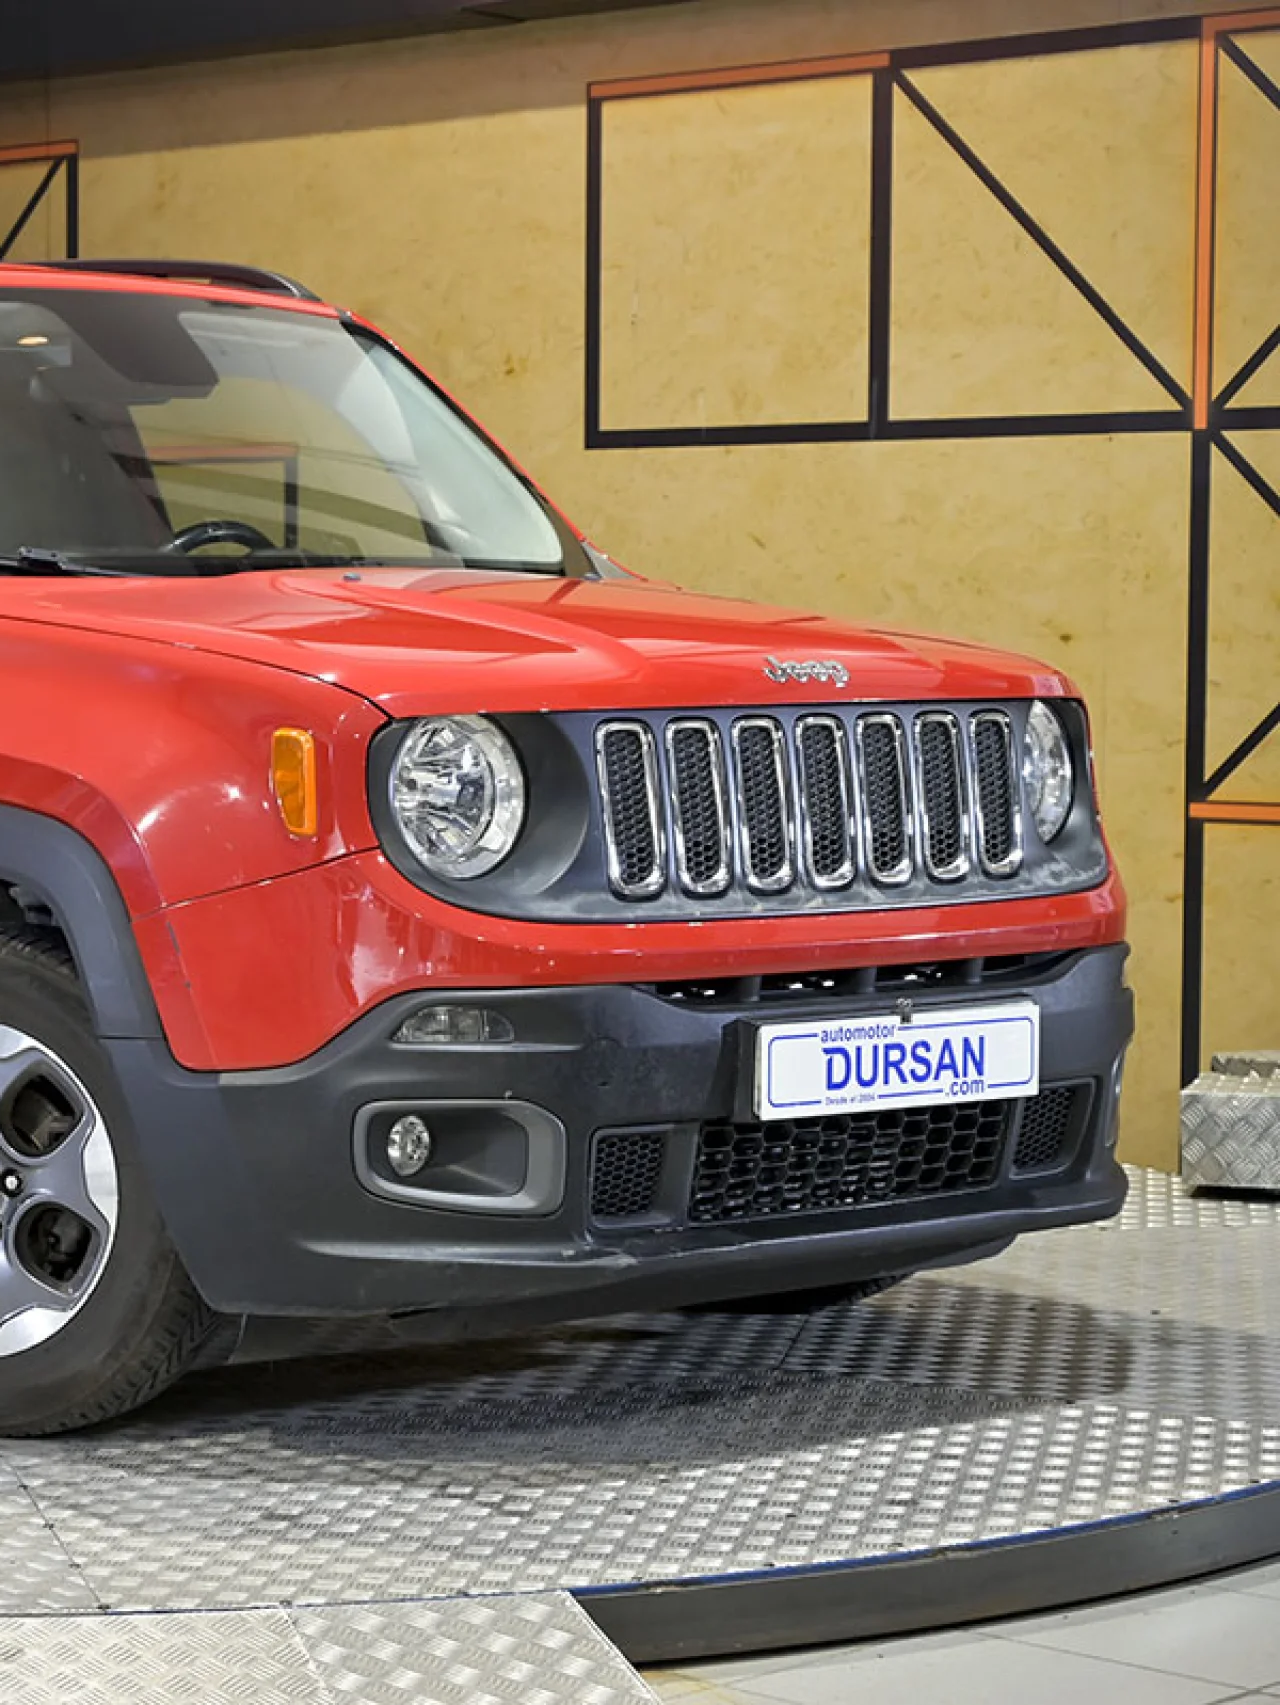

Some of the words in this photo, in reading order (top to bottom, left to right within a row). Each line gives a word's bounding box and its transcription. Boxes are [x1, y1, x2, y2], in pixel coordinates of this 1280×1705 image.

[763, 655, 850, 687] Jeep
[820, 1023, 897, 1043] automotor
[821, 1035, 985, 1091] DURSAN
[944, 1077, 985, 1097] .com
